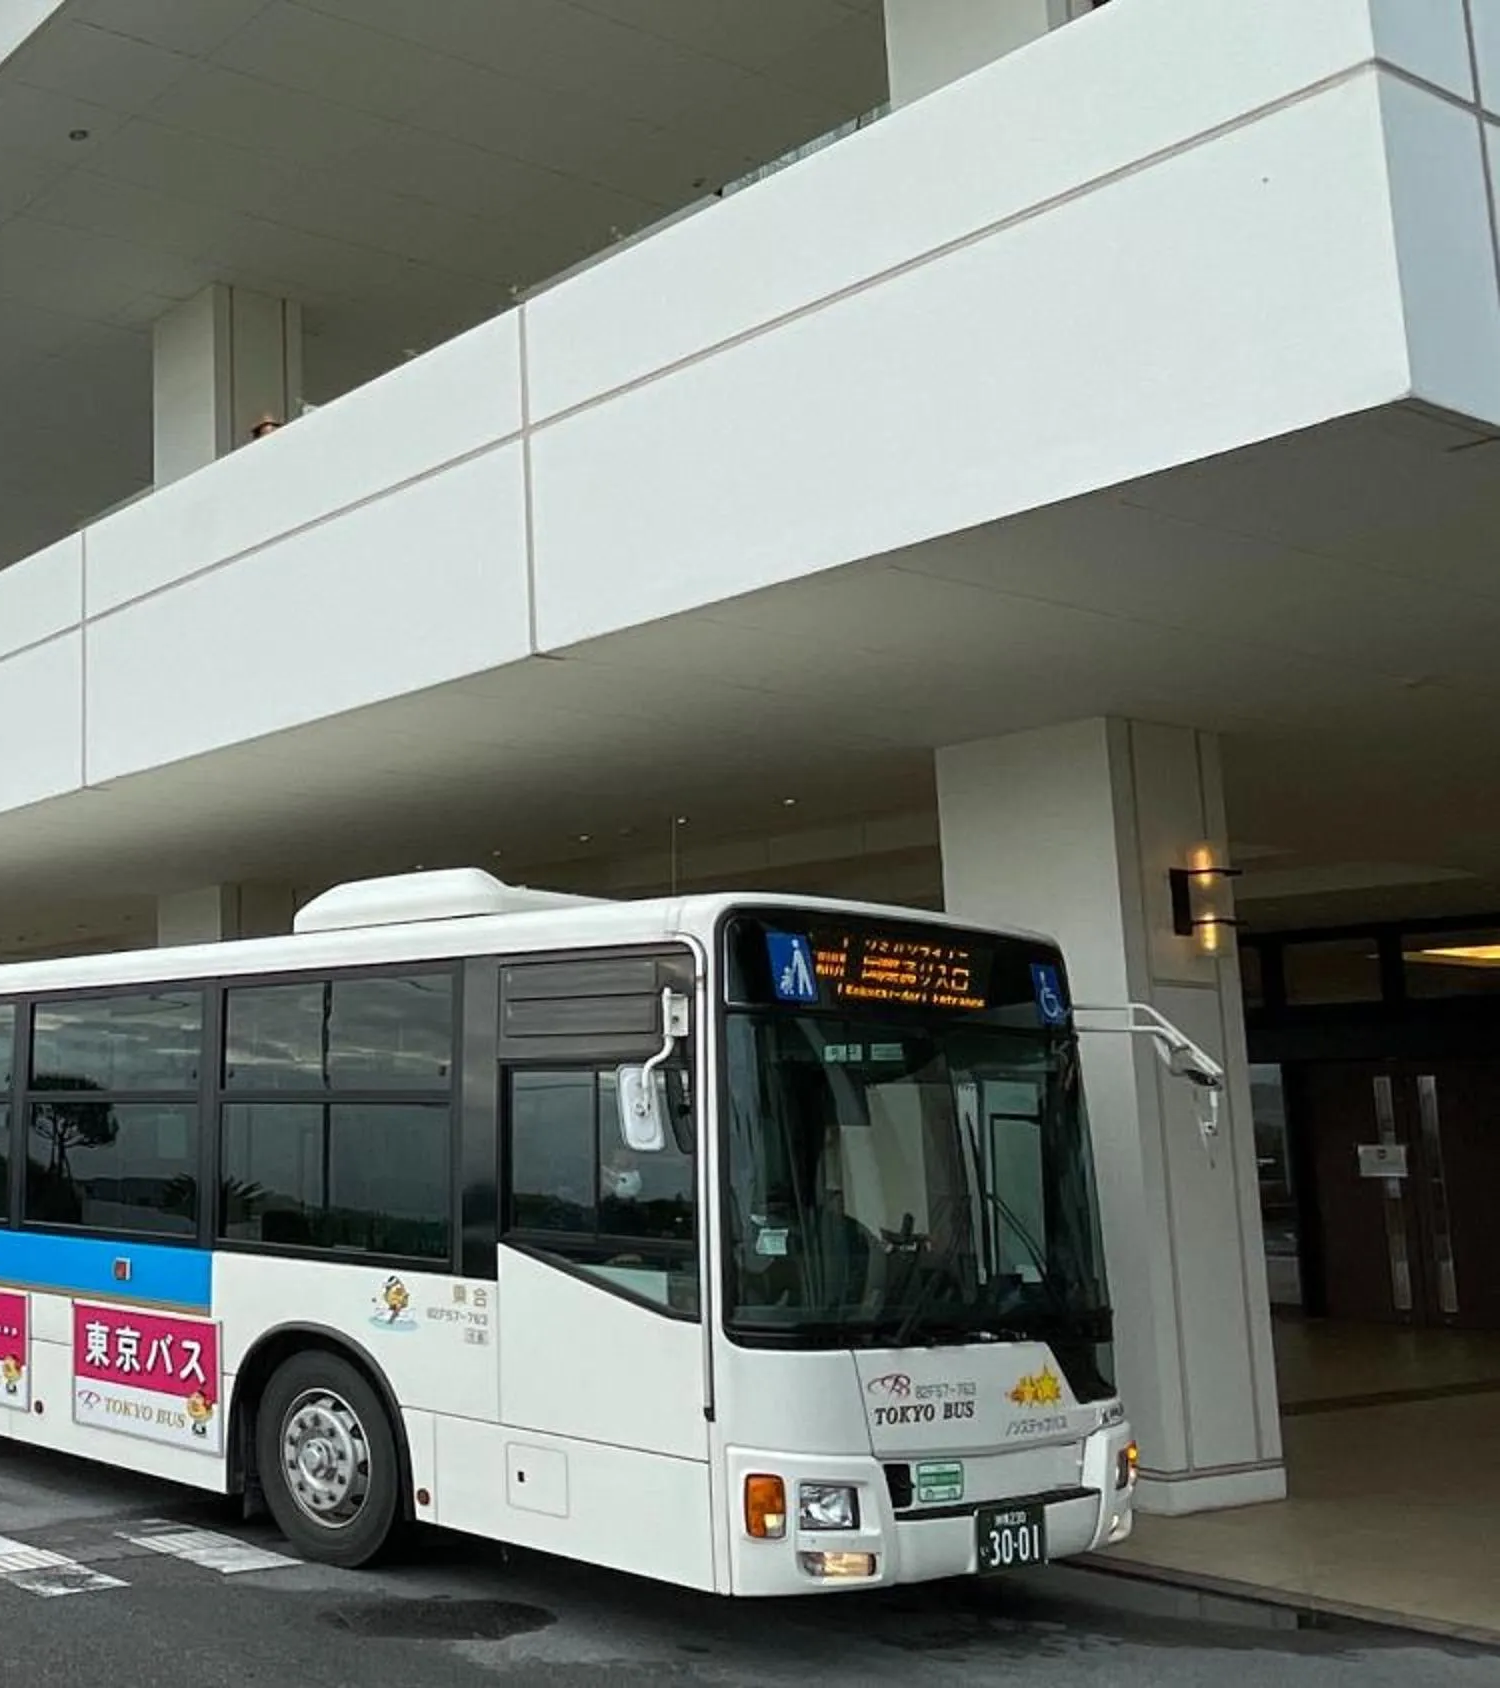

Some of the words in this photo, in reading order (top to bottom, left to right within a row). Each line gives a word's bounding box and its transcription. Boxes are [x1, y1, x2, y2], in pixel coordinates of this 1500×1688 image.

[84, 1320, 206, 1385] 東京バス
[105, 1396, 153, 1421] TOKYO
[155, 1406, 185, 1429] BUS
[875, 1403, 935, 1426] TOKYO
[943, 1401, 974, 1420] BUS
